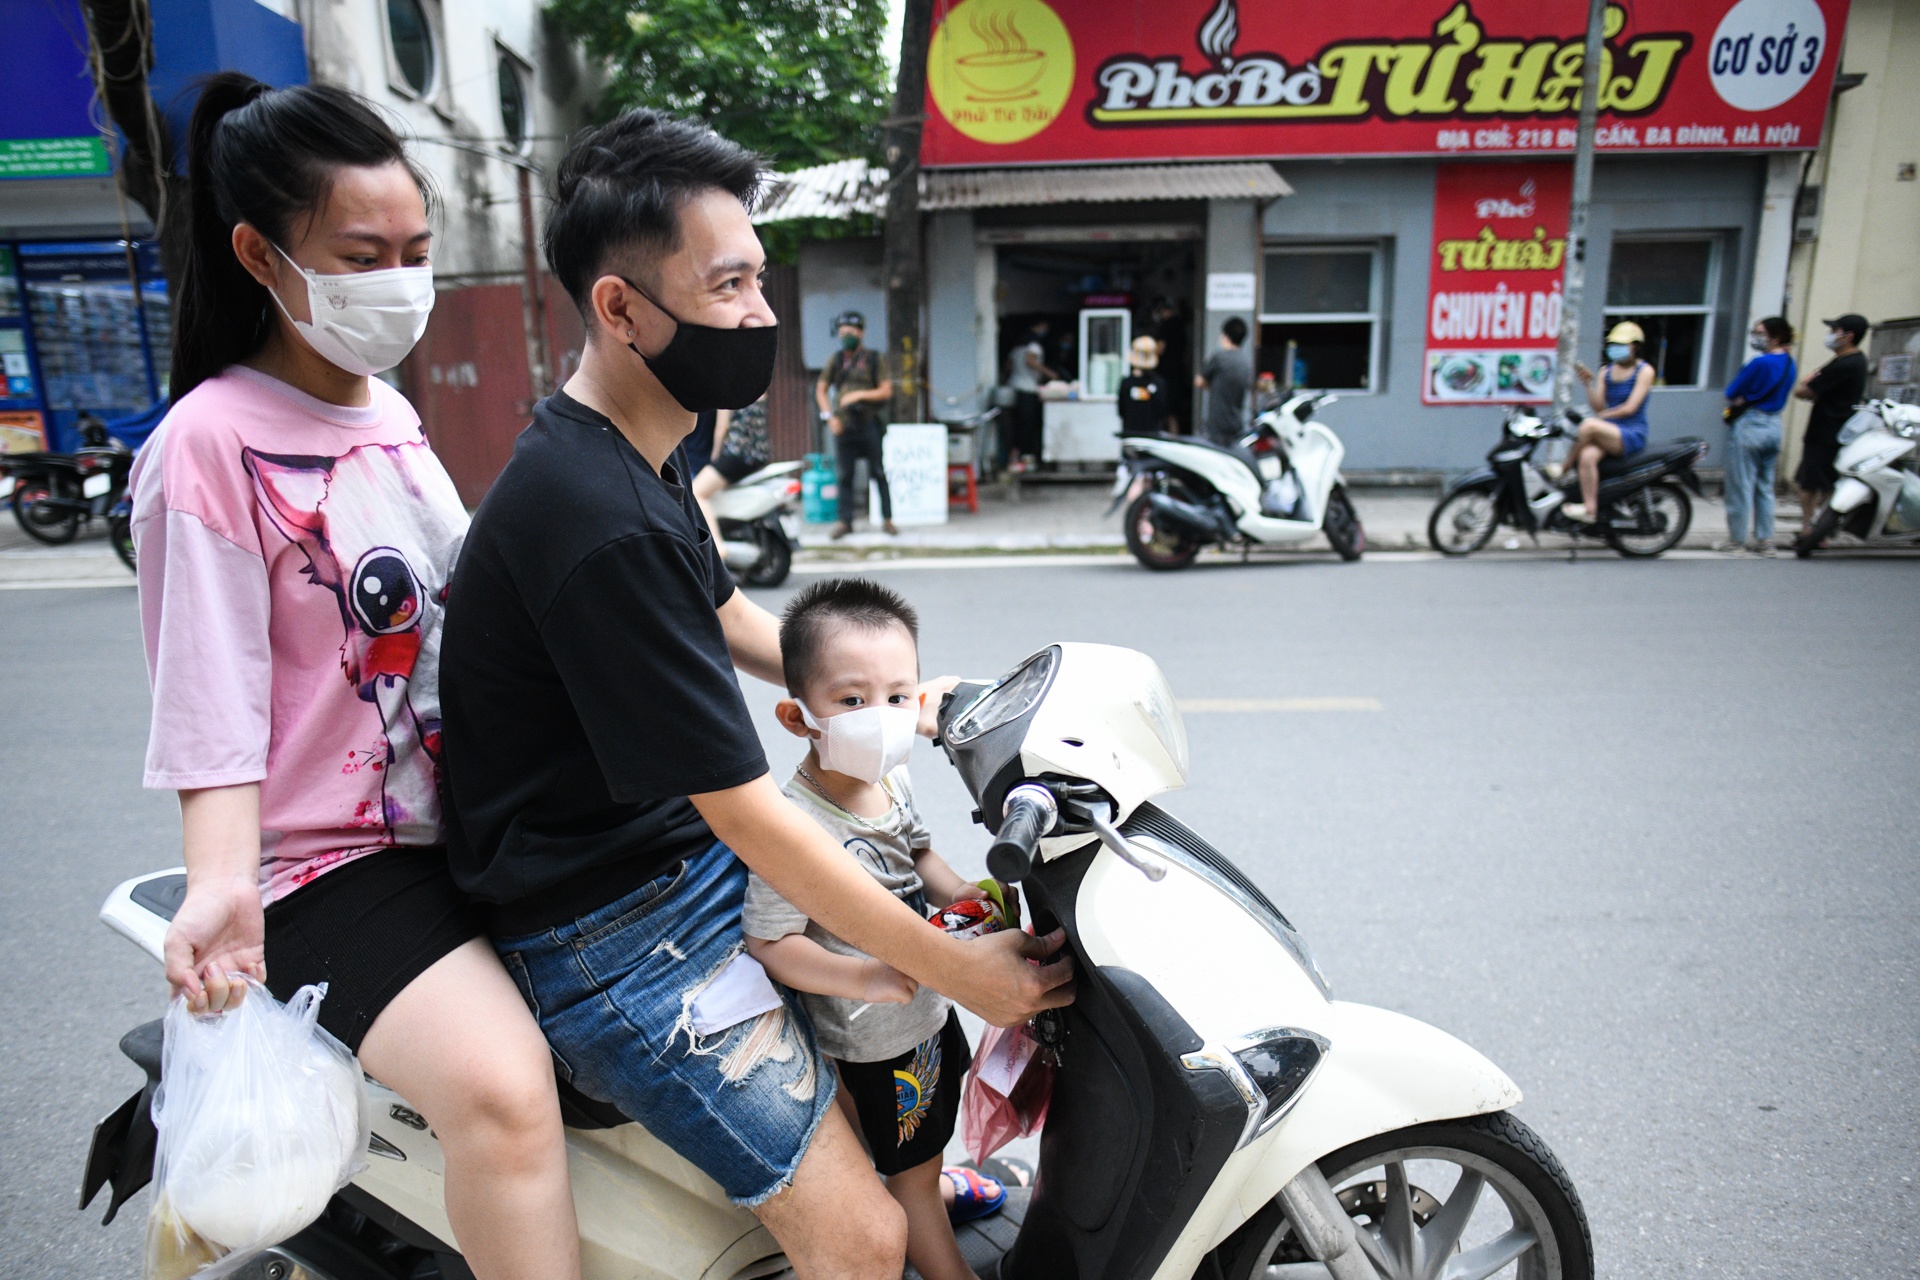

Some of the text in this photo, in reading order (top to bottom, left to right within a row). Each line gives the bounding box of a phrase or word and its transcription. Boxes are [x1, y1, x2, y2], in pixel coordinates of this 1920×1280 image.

[1713, 22, 1820, 76] CƠ SỞ 3
[1431, 280, 1562, 341] CHUYÊN BÒ
